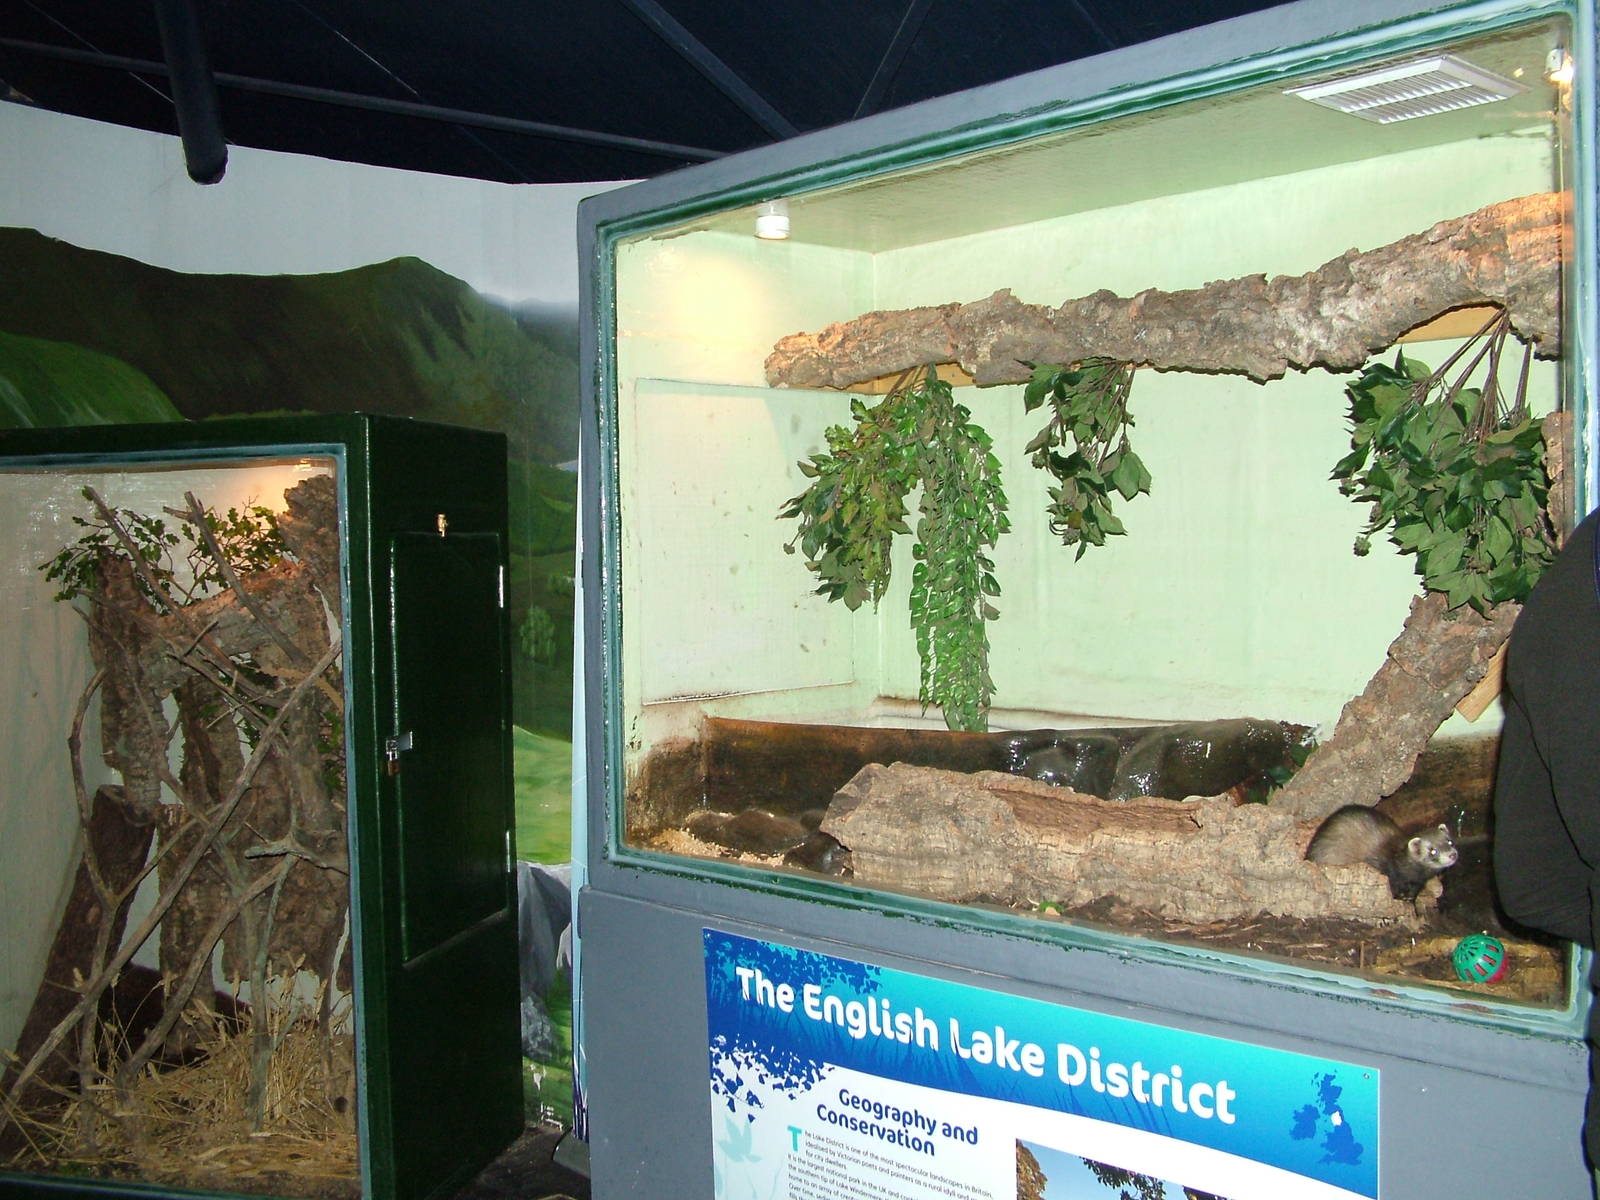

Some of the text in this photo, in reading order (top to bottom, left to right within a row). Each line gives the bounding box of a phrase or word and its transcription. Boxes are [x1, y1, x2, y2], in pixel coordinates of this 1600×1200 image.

[735, 966, 1236, 1125] The English Lake District
[816, 1104, 935, 1156] Conservation
[839, 1088, 978, 1145] Geography and
[812, 1132, 825, 1141] Lake
[826, 1137, 844, 1149] District
[846, 1143, 850, 1151] is
[851, 1147, 861, 1155] one
[862, 1149, 869, 1157] of
[870, 1151, 879, 1160] the
[880, 1156, 894, 1166] most
[895, 1161, 928, 1177] spectacular
[930, 1171, 963, 1189] landscapes
[965, 1183, 970, 1192] in
[836, 1179, 849, 1190] Lake
[837, 1151, 861, 1165] Victorian
[862, 1160, 877, 1171] poets
[878, 1166, 890, 1175] and
[890, 1170, 914, 1183] painters
[928, 1182, 942, 1193] rural
[849, 1176, 860, 1185] park
[868, 1182, 877, 1190] the
